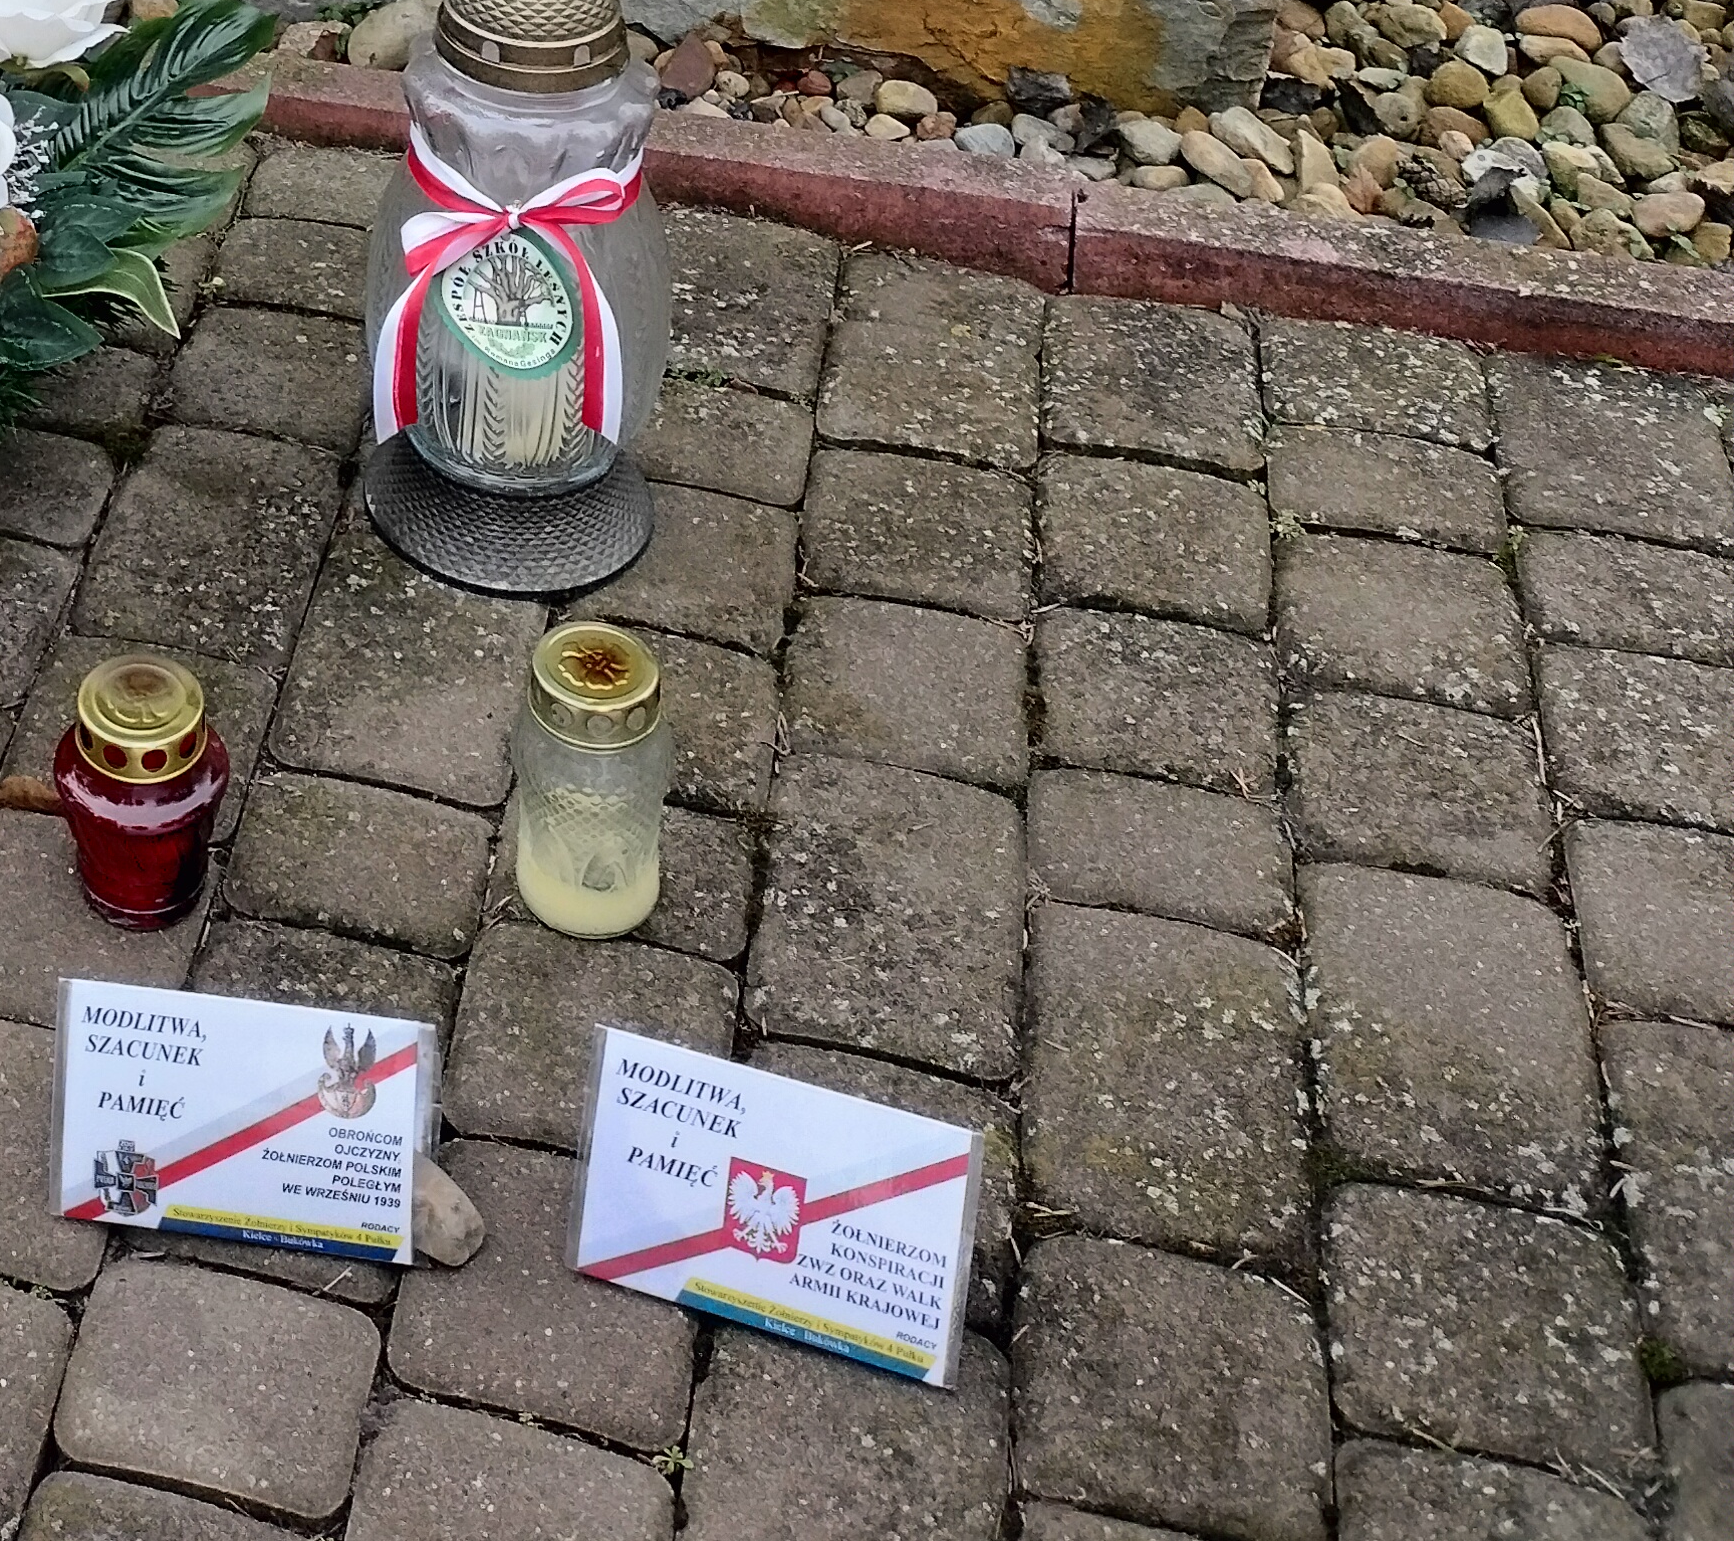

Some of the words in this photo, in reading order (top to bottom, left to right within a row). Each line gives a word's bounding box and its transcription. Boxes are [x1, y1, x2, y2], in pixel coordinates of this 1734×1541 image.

[472, 239, 530, 263] SZKÓŁ
[81, 1005, 208, 1041] MODLITWA,
[85, 1034, 203, 1067] SZACUNEK
[616, 1058, 747, 1114] MODLITWA,
[97, 1091, 186, 1122] PAMIĘĆ
[616, 1087, 742, 1139] SZACUNEK
[328, 1126, 403, 1146] OBROŃCOM
[261, 1147, 343, 1171] ŻOŁNIERZOM
[347, 1160, 402, 1178] POLSKIM
[627, 1145, 718, 1188] PAMIĘĆ
[282, 1182, 302, 1195] WE
[305, 1184, 371, 1205] WRZEŚNIU
[374, 1194, 401, 1208] 1939
[332, 1175, 401, 1194] POLEGŁYM
[361, 1222, 400, 1233] RODACY
[831, 1220, 947, 1268] ŻOŁNIERZOM
[796, 1253, 837, 1277] ZWZ
[840, 1265, 887, 1292] ORAZ
[891, 1282, 942, 1310] WALK
[831, 1243, 945, 1289] KONSPIRACJI
[789, 1273, 842, 1300] ARMII
[846, 1289, 940, 1331] KRAJOWEJ
